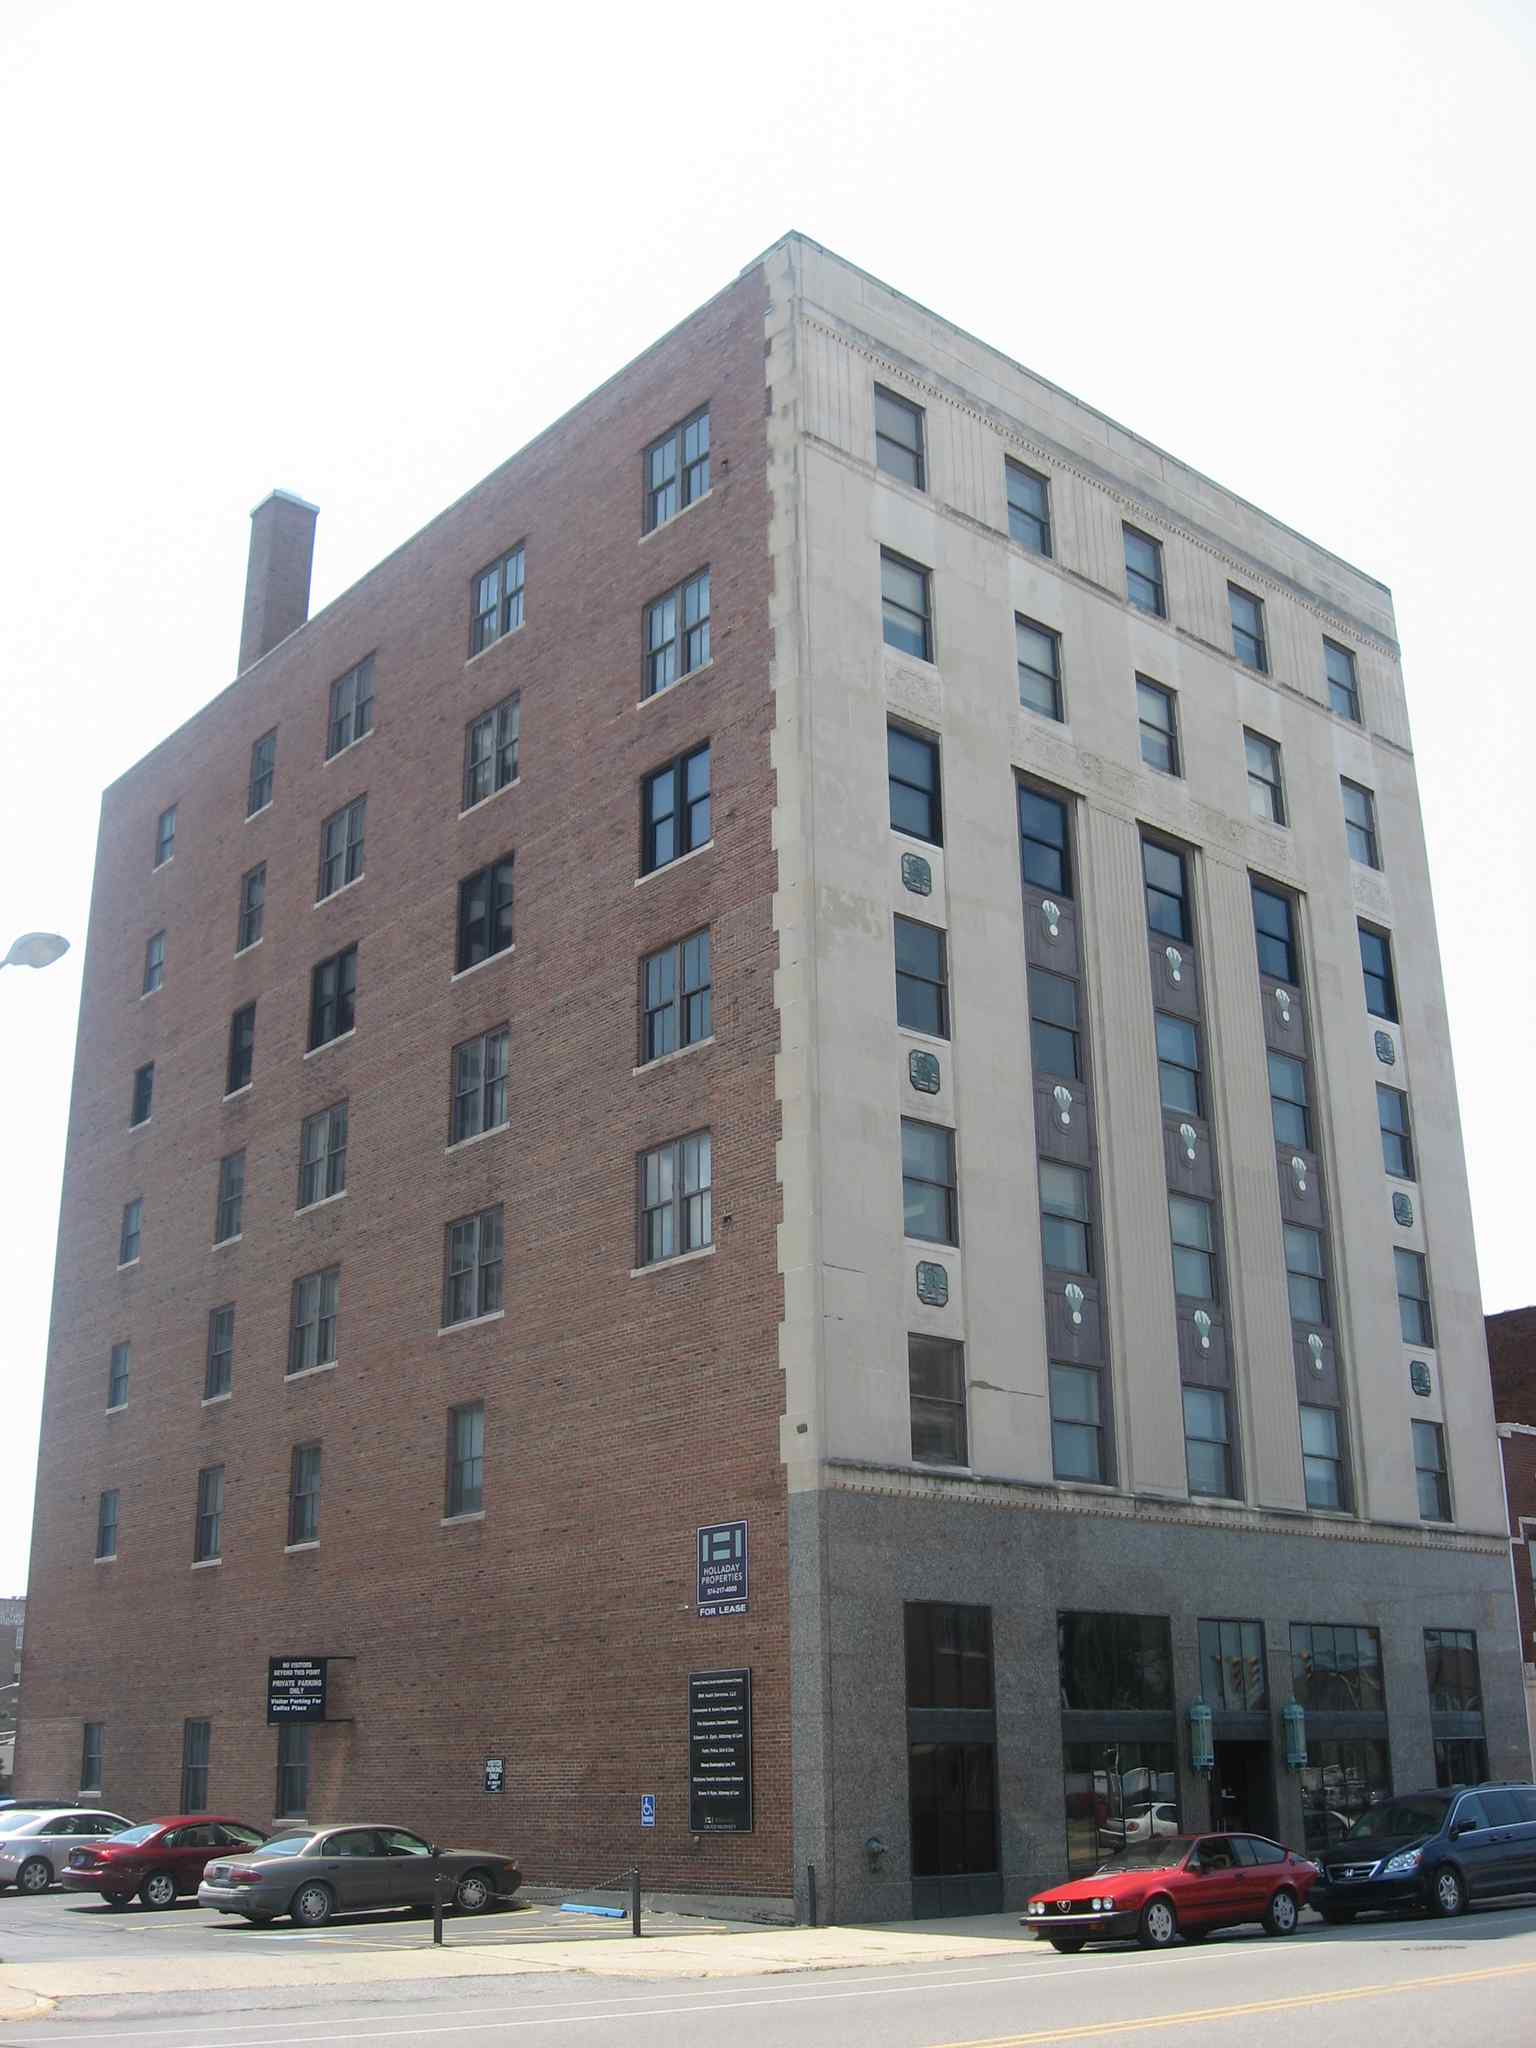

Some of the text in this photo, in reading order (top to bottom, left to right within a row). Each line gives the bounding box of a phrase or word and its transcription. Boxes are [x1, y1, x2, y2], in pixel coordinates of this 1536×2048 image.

[703, 1563, 740, 1576] HOLLADAY
[701, 1572, 743, 1584] PROPERTIES
[700, 1604, 746, 1616] FOR LEASE
